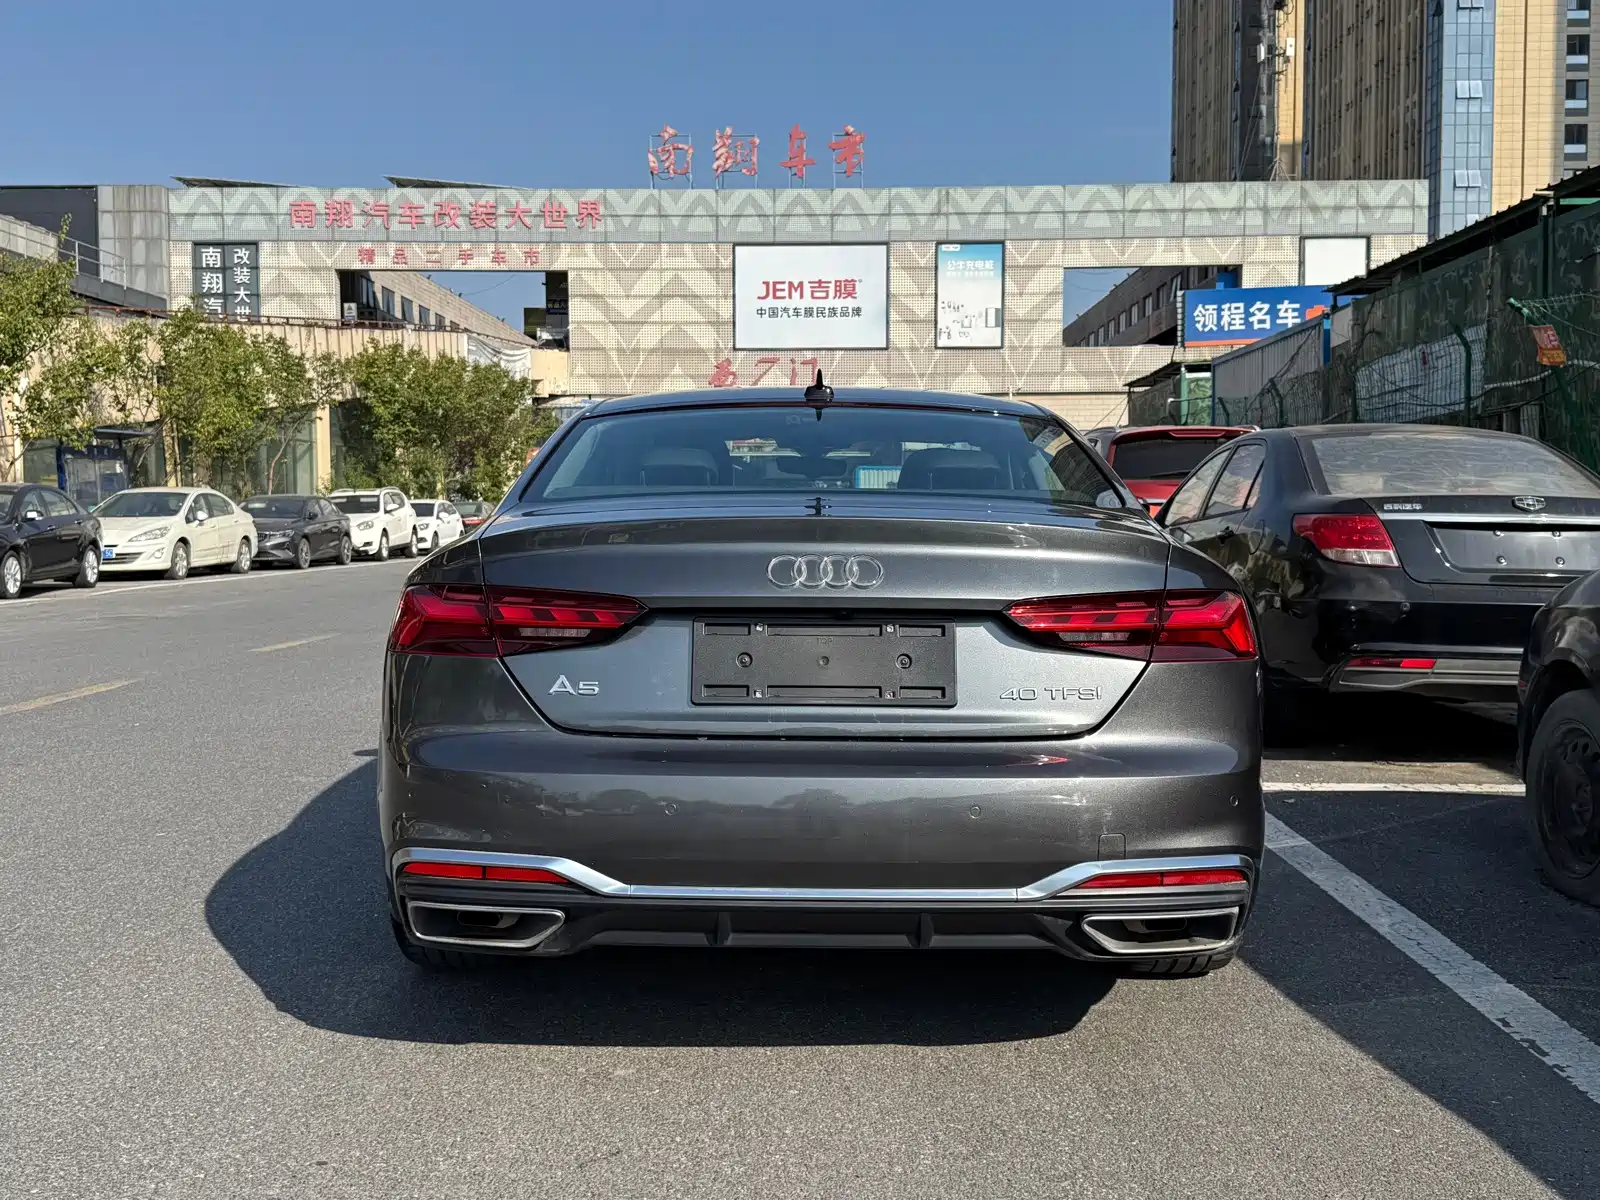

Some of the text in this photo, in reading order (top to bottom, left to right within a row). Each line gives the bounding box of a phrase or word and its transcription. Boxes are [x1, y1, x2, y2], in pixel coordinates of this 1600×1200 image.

[648, 123, 867, 179] 南翔车市
[289, 200, 604, 230] 南翔汽车改装大世界
[358, 247, 542, 266] 精品二手车市
[756, 306, 863, 319] 中国汽车膜民族品牌
[1193, 299, 1302, 332] 领程名车
[548, 674, 600, 697] A5
[1000, 687, 1038, 700] 40
